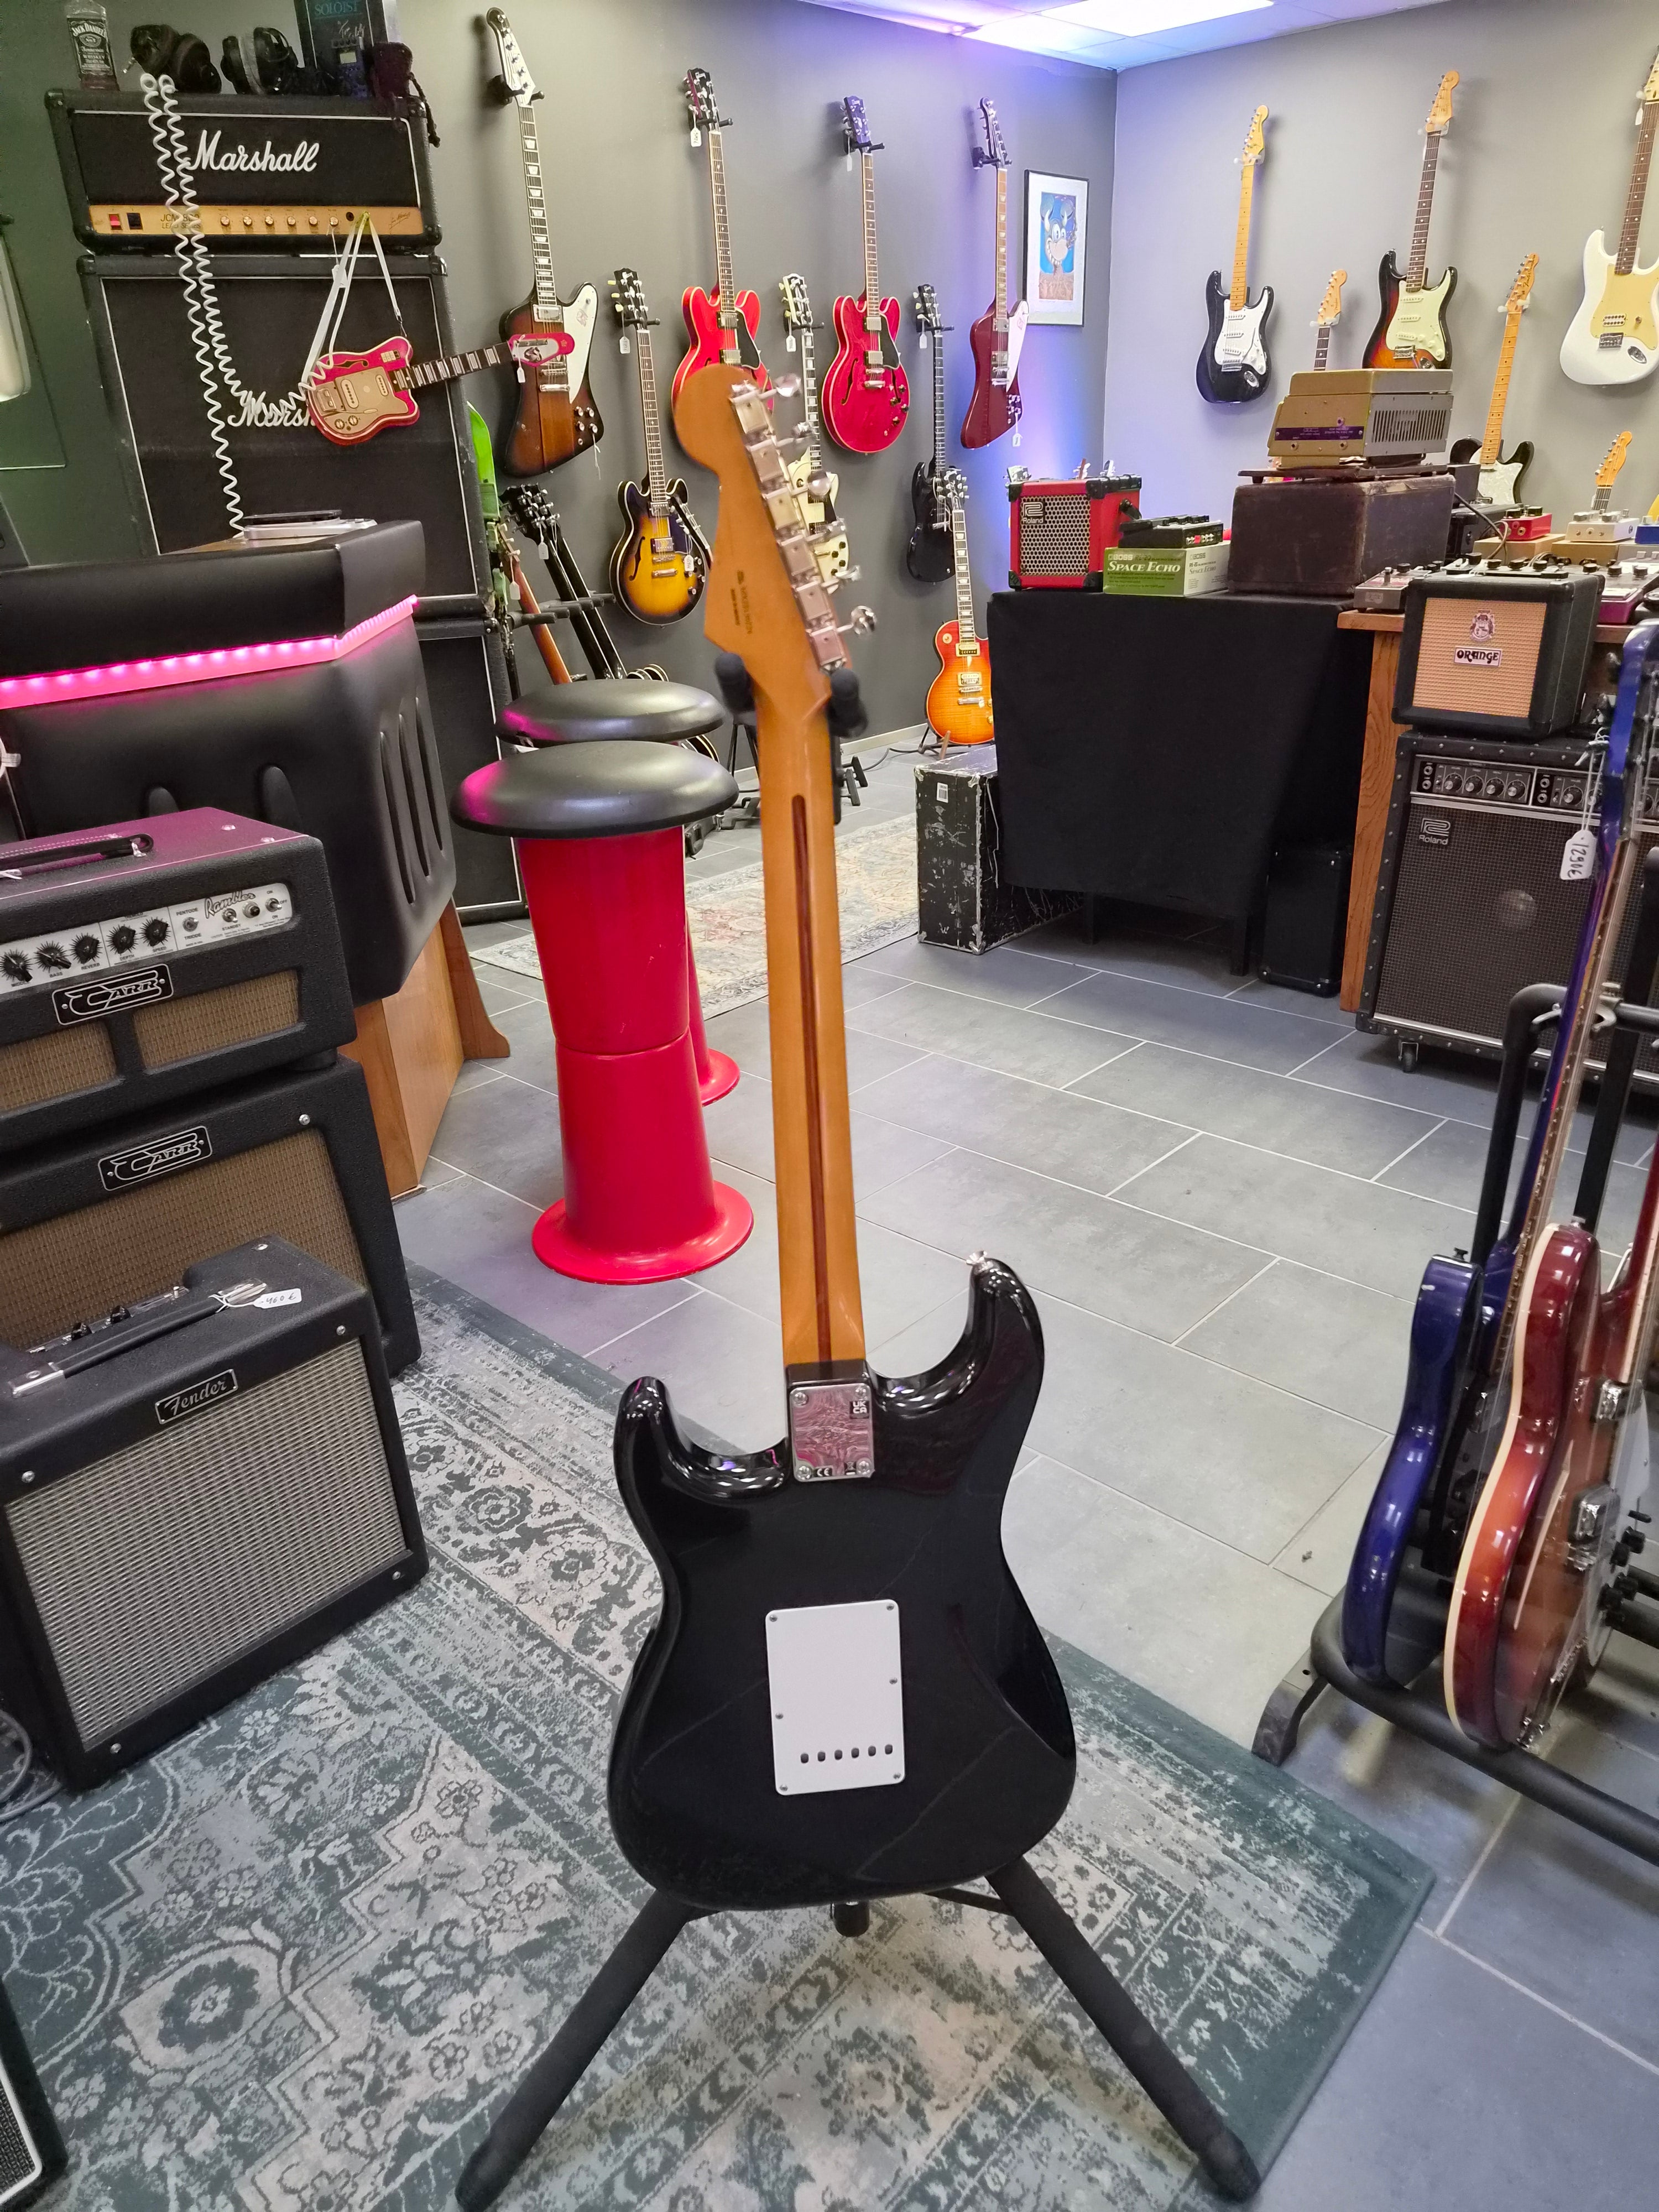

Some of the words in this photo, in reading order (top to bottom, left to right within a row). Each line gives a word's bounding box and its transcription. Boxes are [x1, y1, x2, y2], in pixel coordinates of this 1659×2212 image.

[71, 24, 86, 36] JACK
[185, 129, 320, 172] Marshall
[1457, 650, 1499, 664] ORANGE
[1419, 834, 1448, 845] Roland
[176, 907, 199, 916] PENTODE
[204, 891, 255, 919] Rambler
[65, 970, 161, 1015] CARR
[110, 1133, 201, 1181] CARR
[164, 1380, 227, 1416] Fender
[816, 1468, 830, 1477] CE
